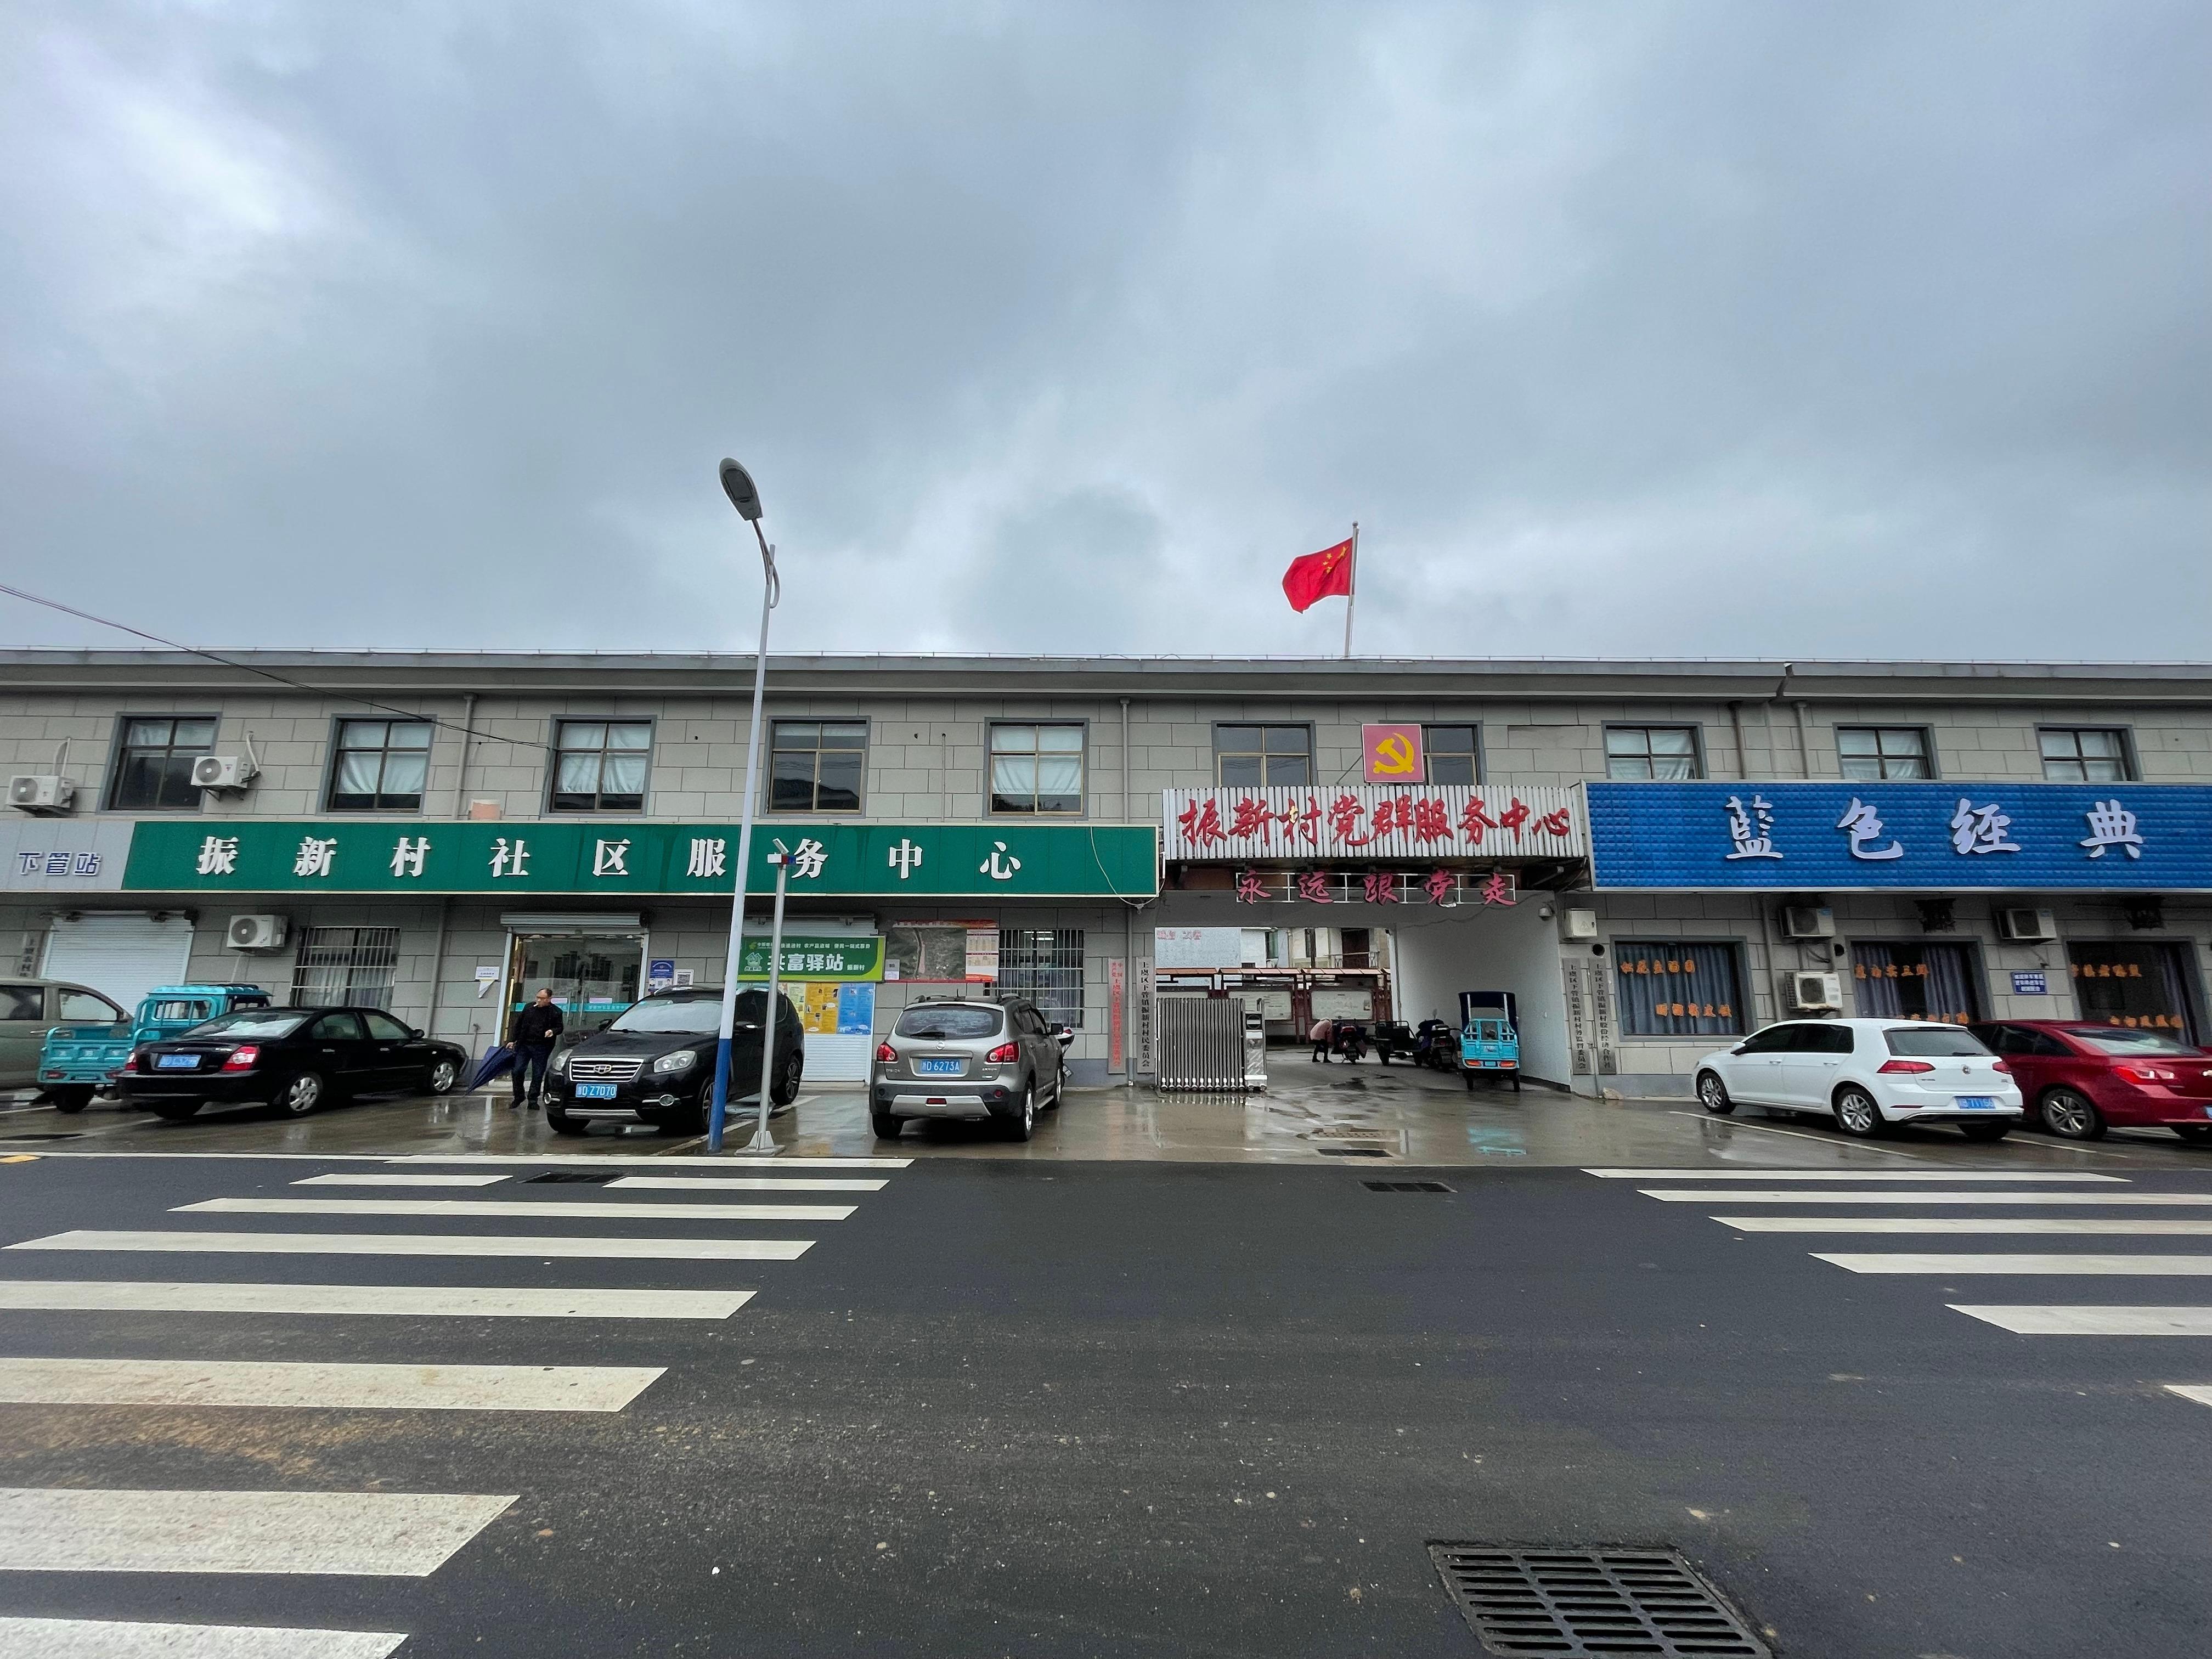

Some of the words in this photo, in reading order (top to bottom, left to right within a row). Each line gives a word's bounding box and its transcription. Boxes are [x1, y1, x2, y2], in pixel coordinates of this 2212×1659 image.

[1178, 794, 1570, 847] 振新村党群服务中心
[17, 851, 101, 876] 下管站
[197, 836, 1022, 879] 振新村社区服务中心
[1237, 869, 1517, 906] 永远跟党走
[767, 953, 844, 972] 共富驿站
